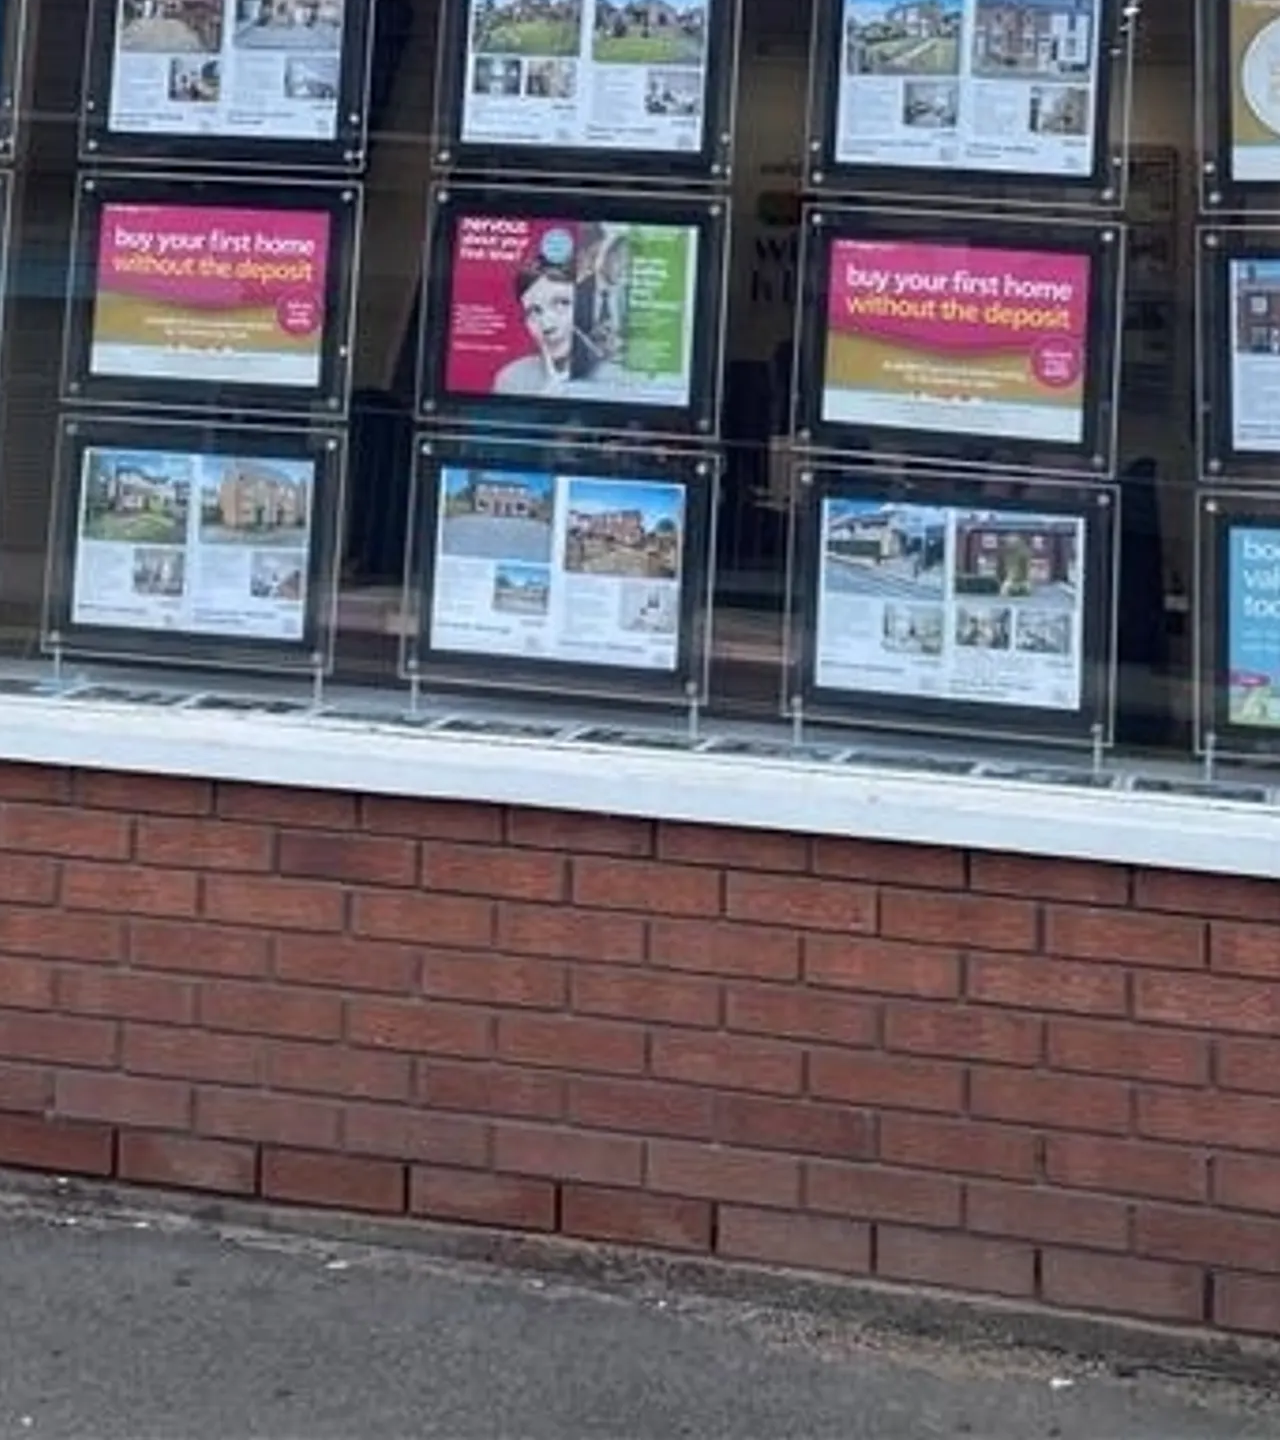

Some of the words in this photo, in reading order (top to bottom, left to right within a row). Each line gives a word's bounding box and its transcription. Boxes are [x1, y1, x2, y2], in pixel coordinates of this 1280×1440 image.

[157, 232, 206, 254] your
[846, 263, 890, 293] buy
[892, 271, 949, 294] your
[952, 269, 1001, 296] first
[1004, 273, 1073, 302] home
[846, 295, 936, 320] without
[939, 296, 979, 323] the
[984, 300, 1071, 333] deposit
